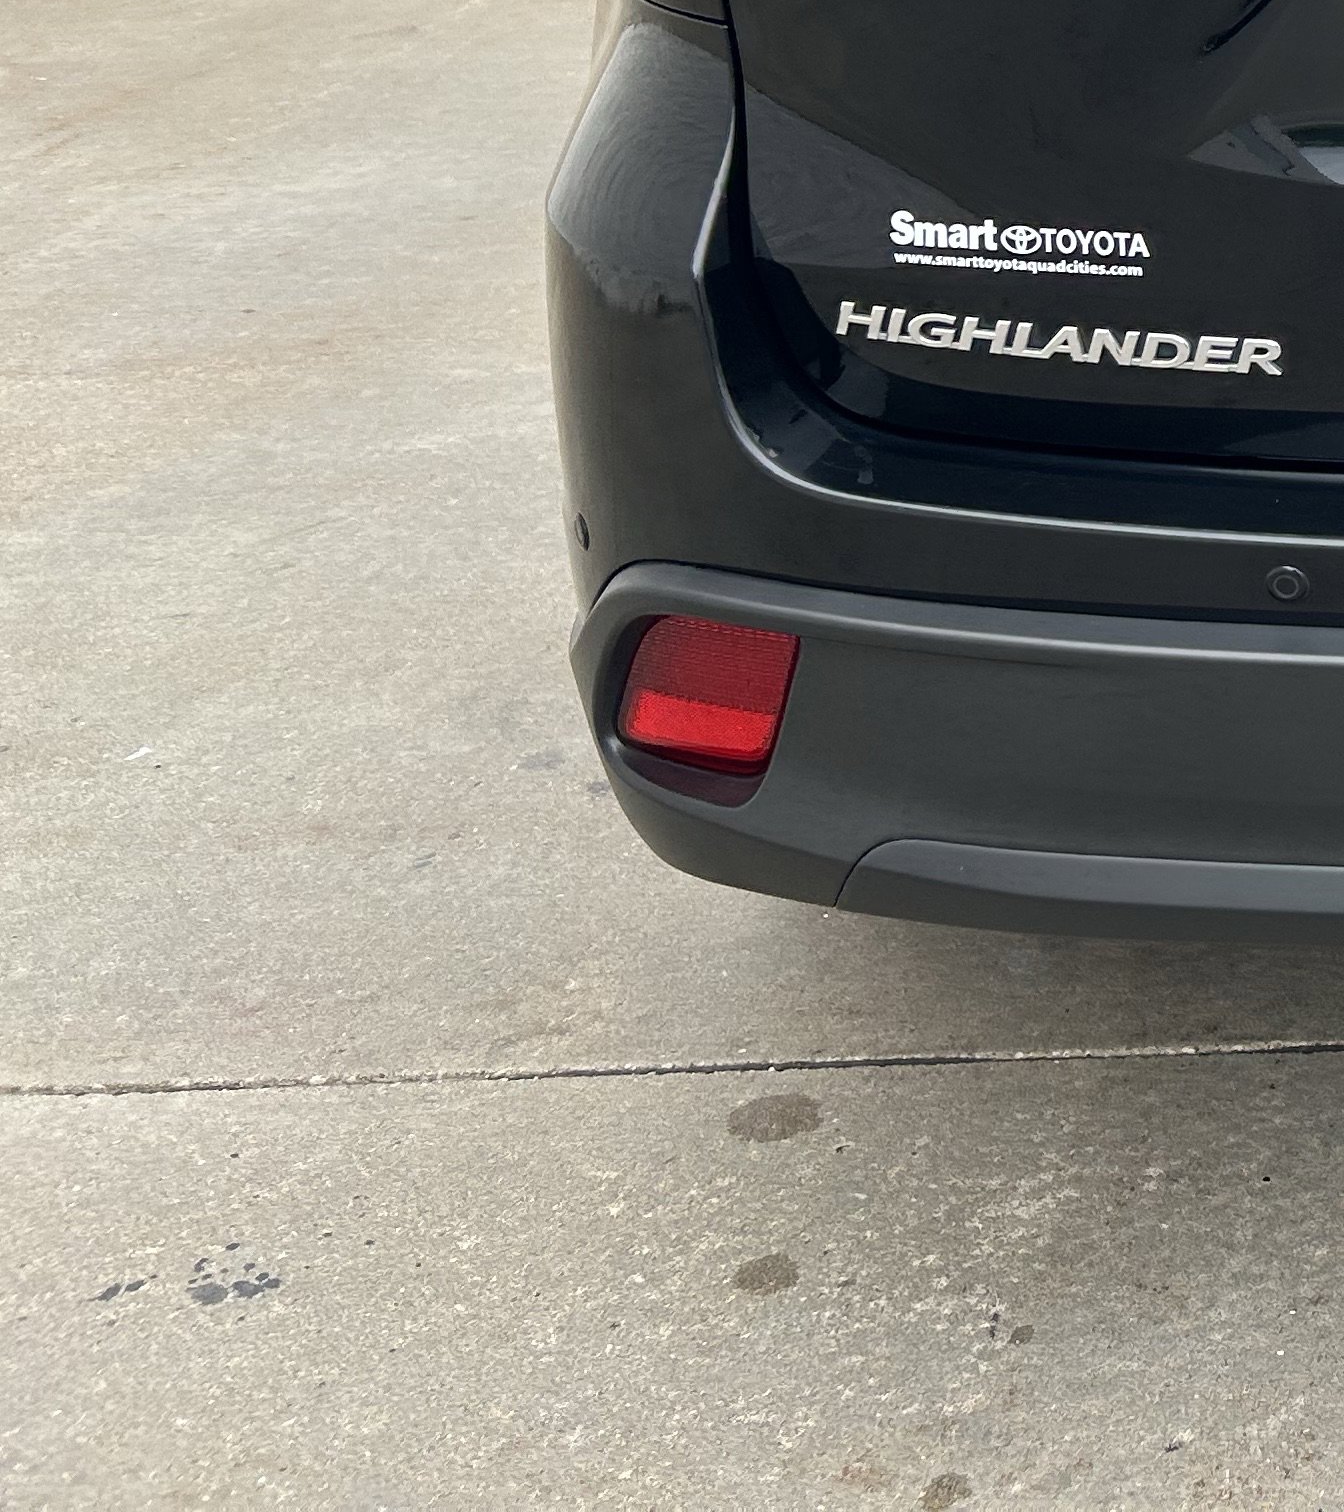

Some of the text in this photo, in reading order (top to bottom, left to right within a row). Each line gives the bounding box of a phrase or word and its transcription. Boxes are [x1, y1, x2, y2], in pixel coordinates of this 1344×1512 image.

[889, 209, 1151, 259] Smart TOYOTA
[893, 250, 1144, 277] www.smarttoyotaquadcities.com
[835, 300, 1283, 376] HIGHLANDER
